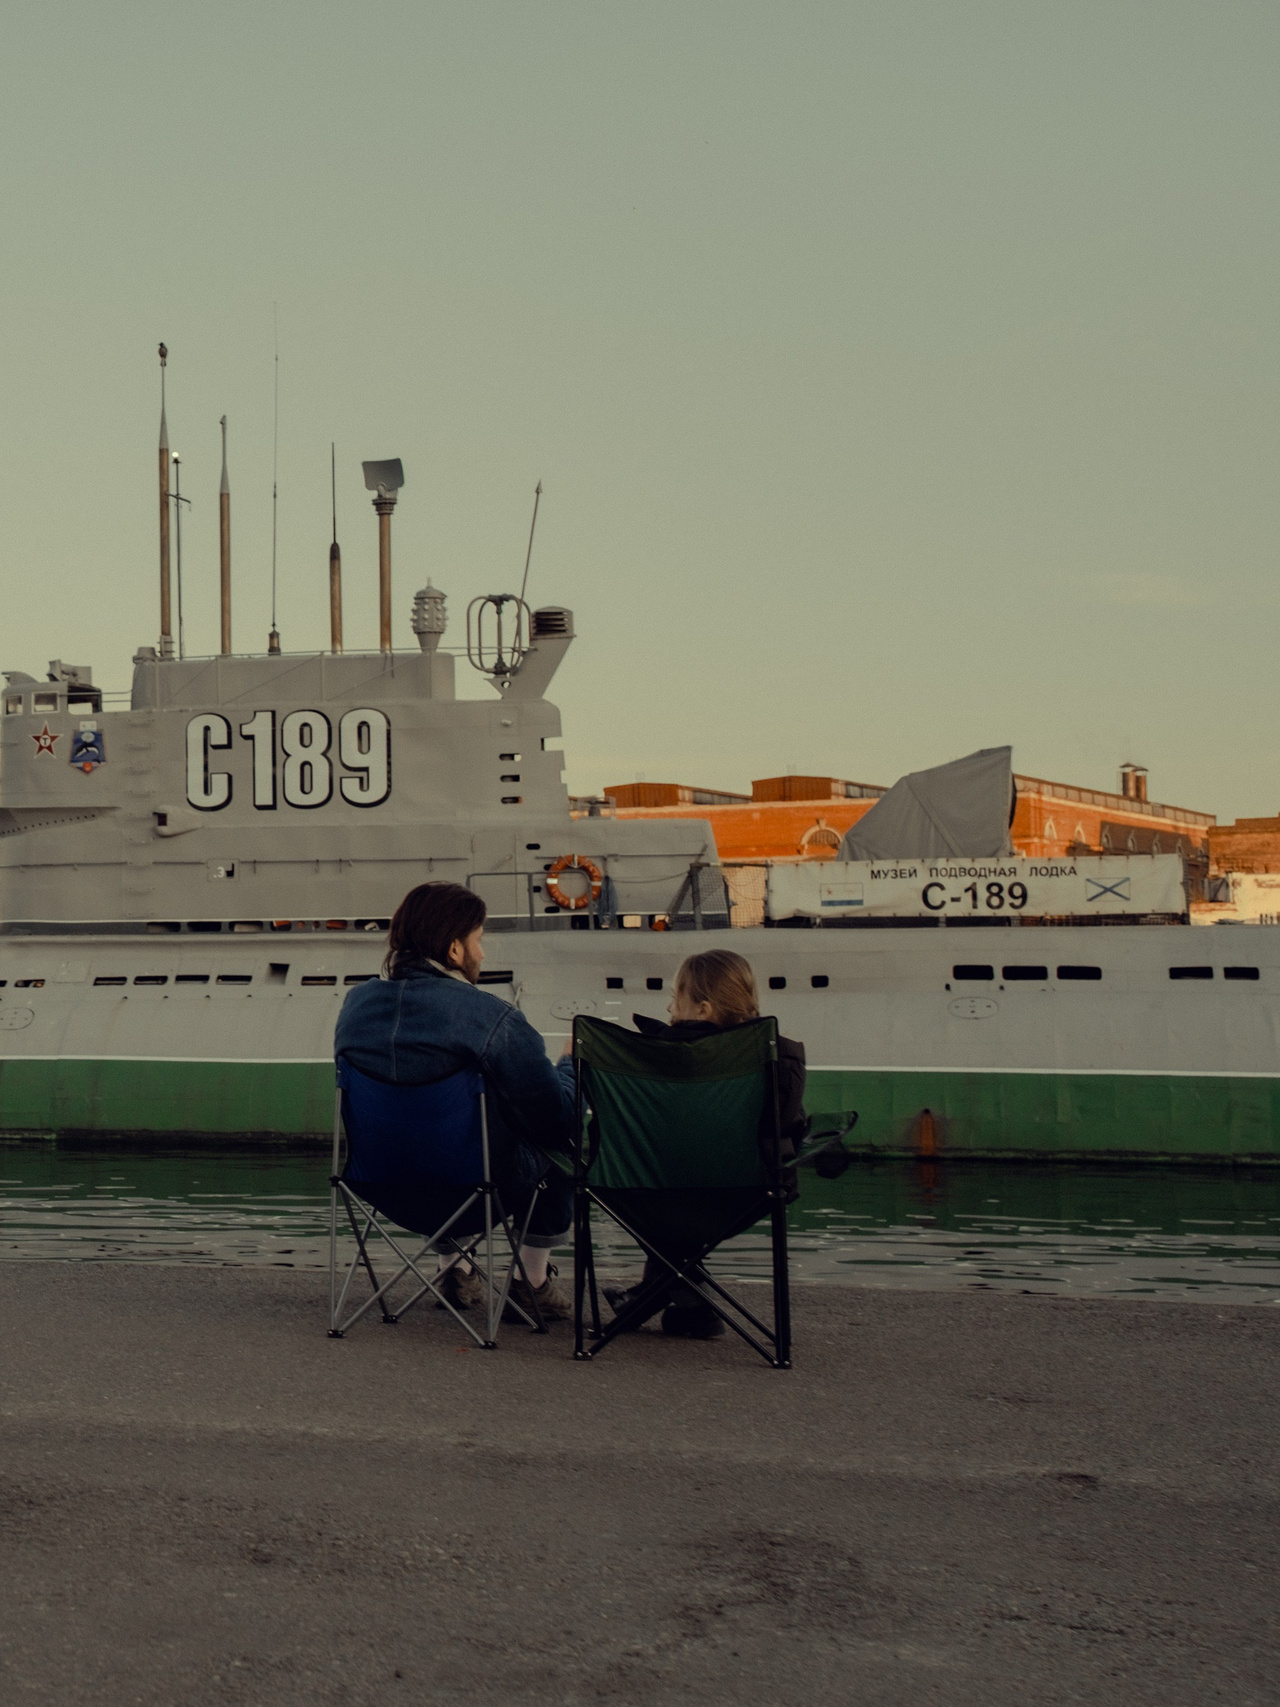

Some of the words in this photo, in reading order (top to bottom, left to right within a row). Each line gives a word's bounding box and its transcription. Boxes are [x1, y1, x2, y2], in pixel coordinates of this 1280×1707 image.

[186, 707, 392, 812] С189
[870, 867, 918, 879] МУЗЕЙ
[929, 867, 1017, 879] ПОДВОДНАЯ
[1029, 866, 1077, 878] ЛОДКА
[921, 882, 1028, 910] С-189
